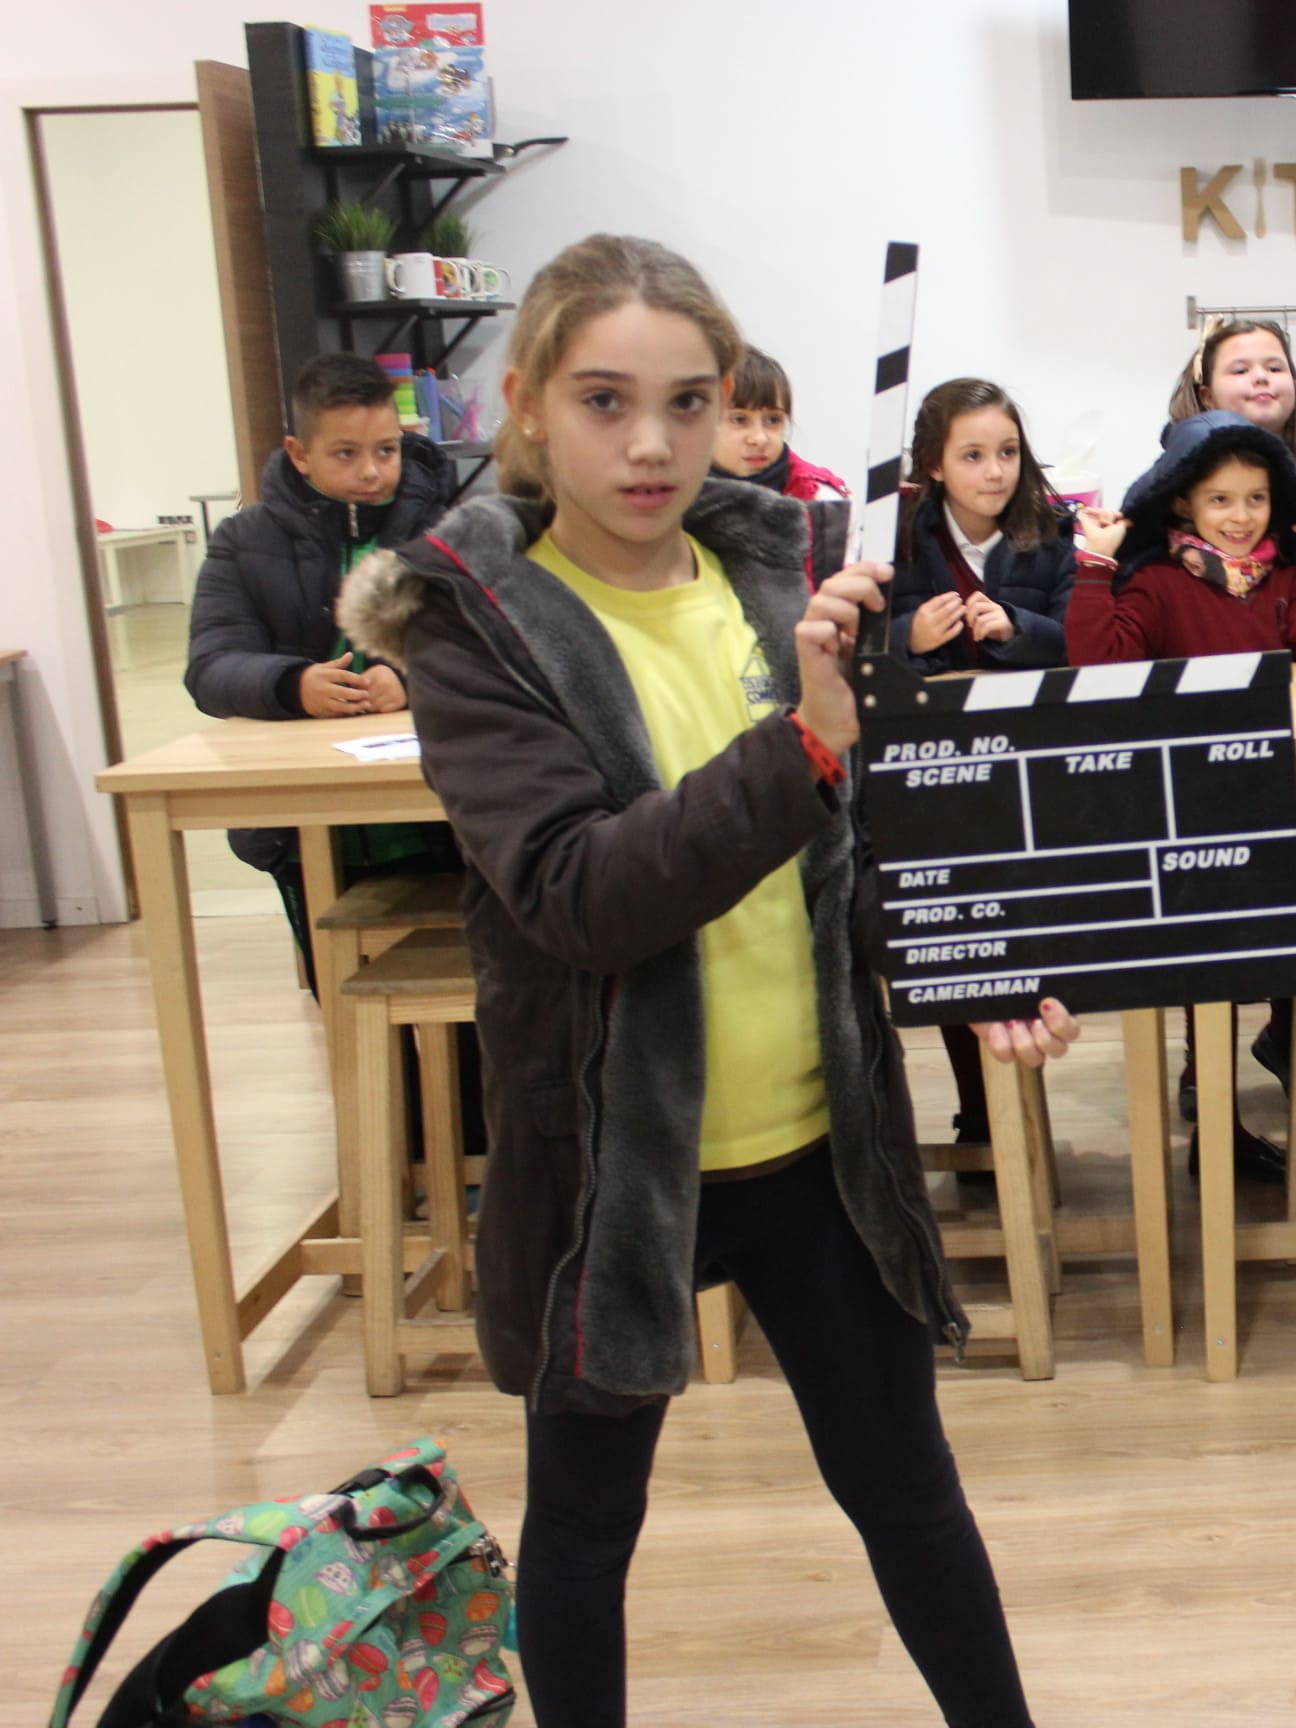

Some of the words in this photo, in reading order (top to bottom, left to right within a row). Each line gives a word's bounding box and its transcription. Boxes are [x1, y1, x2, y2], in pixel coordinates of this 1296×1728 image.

[883, 740, 961, 762] PROD.
[971, 735, 1015, 755] NO.
[1208, 740, 1274, 762] ROLL
[1064, 751, 1133, 774] TAKE
[906, 764, 992, 788] SCENE
[1162, 847, 1251, 871] SOUND
[899, 869, 950, 888] DATE
[902, 906, 964, 926] PROD.
[970, 902, 1006, 919] CO.
[906, 941, 1007, 964] DIRECTOR
[908, 978, 1040, 1003] CAMERAMAN
